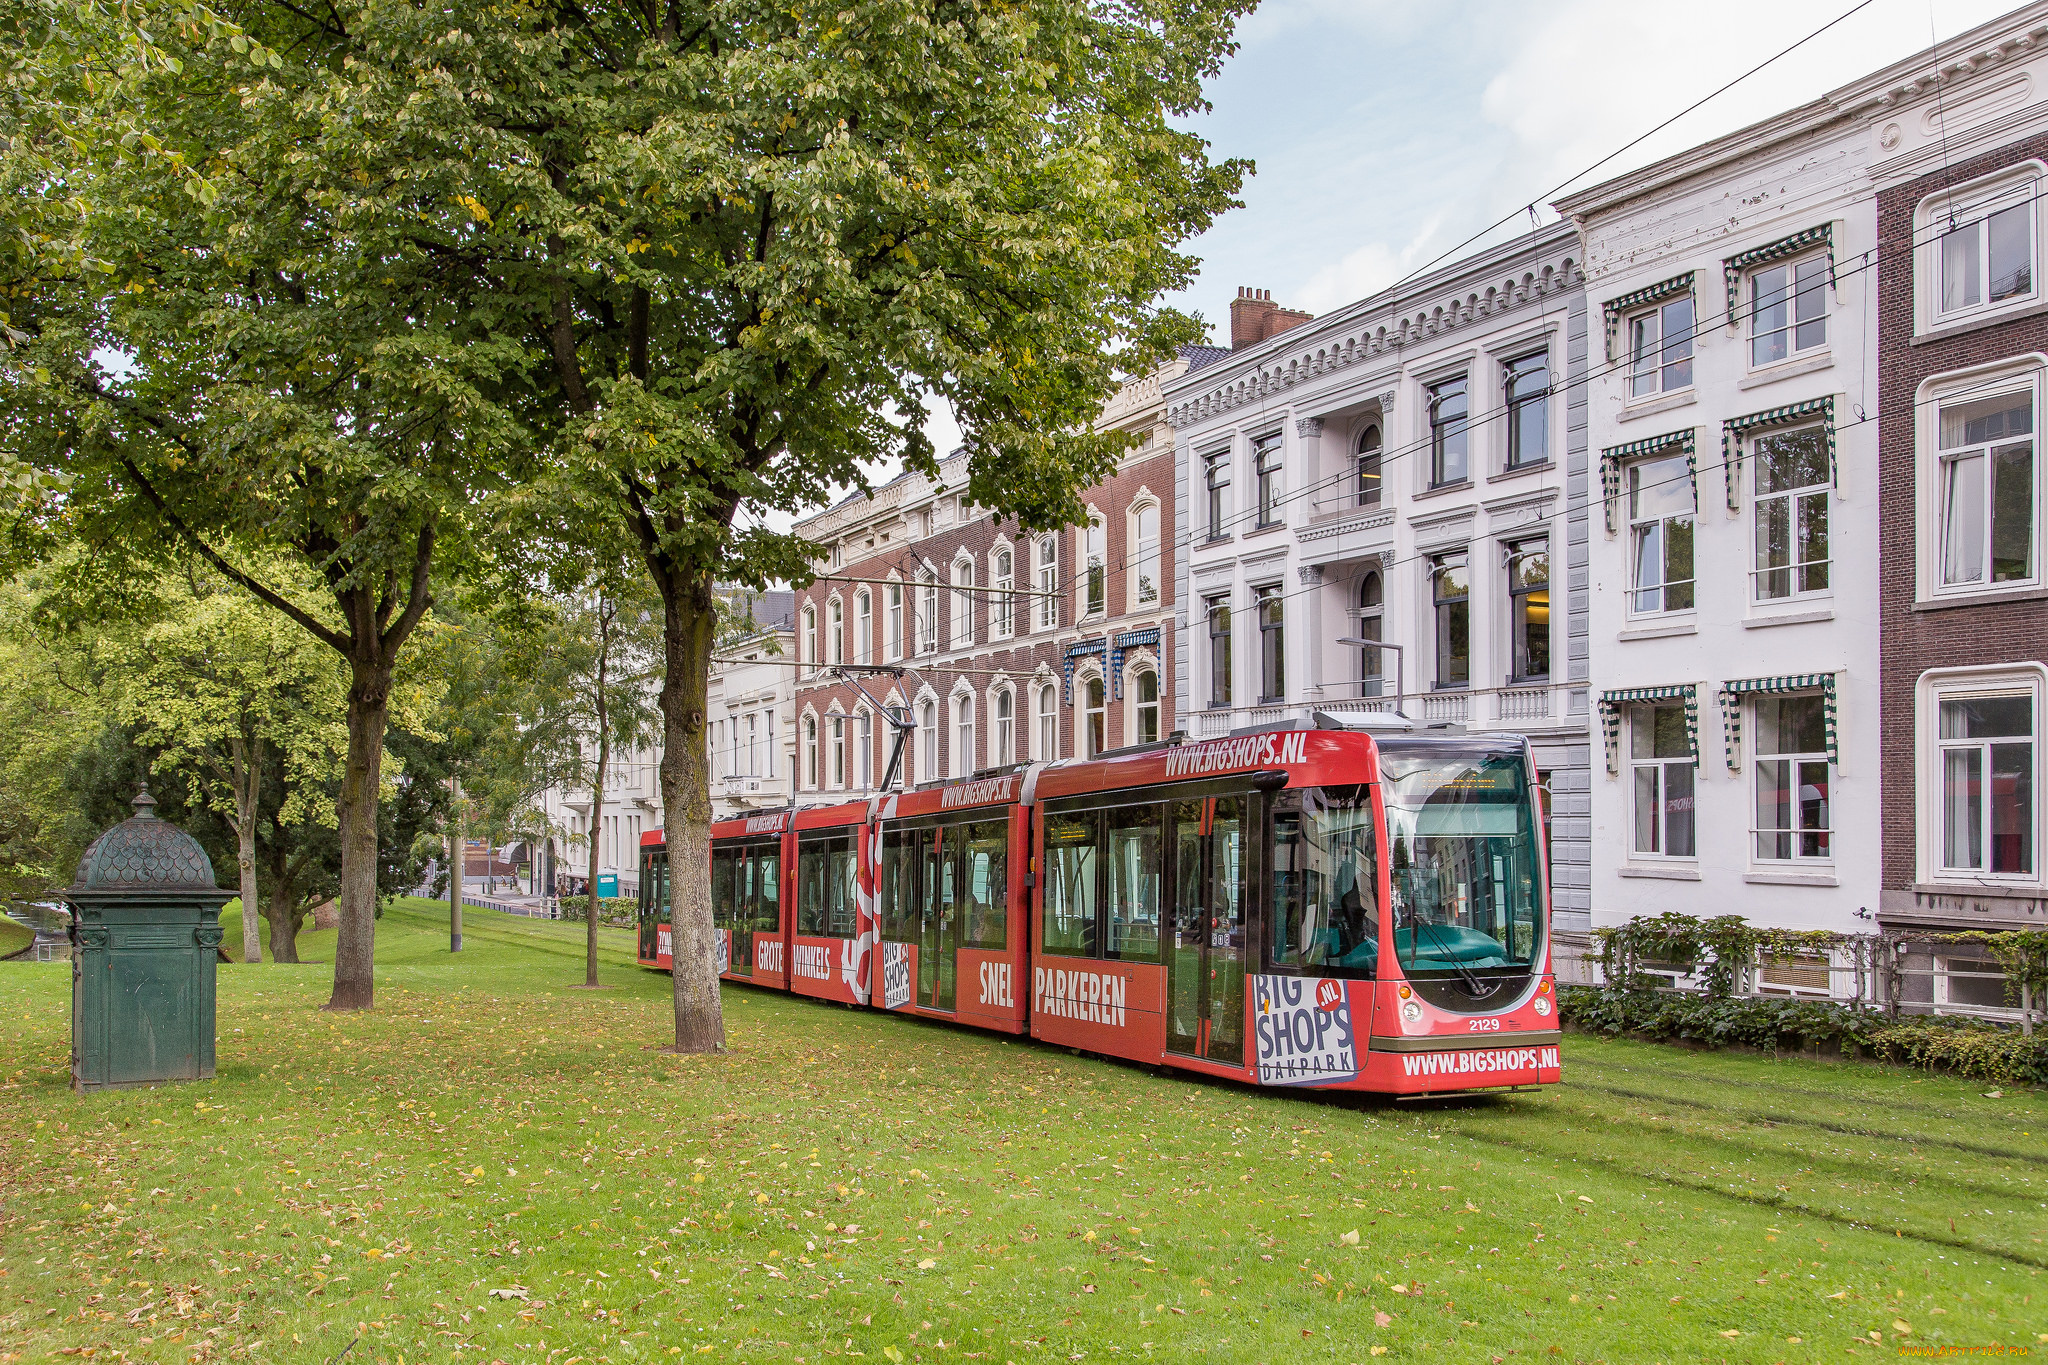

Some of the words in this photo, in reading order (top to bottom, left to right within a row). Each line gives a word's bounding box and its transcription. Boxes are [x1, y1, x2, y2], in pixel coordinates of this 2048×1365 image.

[1165, 732, 1308, 777] WWW.BIGSHOPS.NL
[941, 777, 1013, 808] WWW.BIGSHOPS.NL
[758, 940, 783, 973] GROTE
[793, 944, 830, 981] WINKELS
[884, 942, 898, 964] BIG
[885, 961, 909, 993] SHOPS
[1255, 974, 1302, 1012] BIG
[979, 960, 1014, 1008] SNEL
[1035, 966, 1126, 1027] PARKEREN
[1257, 1000, 1352, 1059] SHOPS
[1469, 1018, 1500, 1031] 2129
[1262, 1051, 1350, 1081] DAKPARK
[1402, 1048, 1560, 1076] WWW.BIGSHOPS.NL
